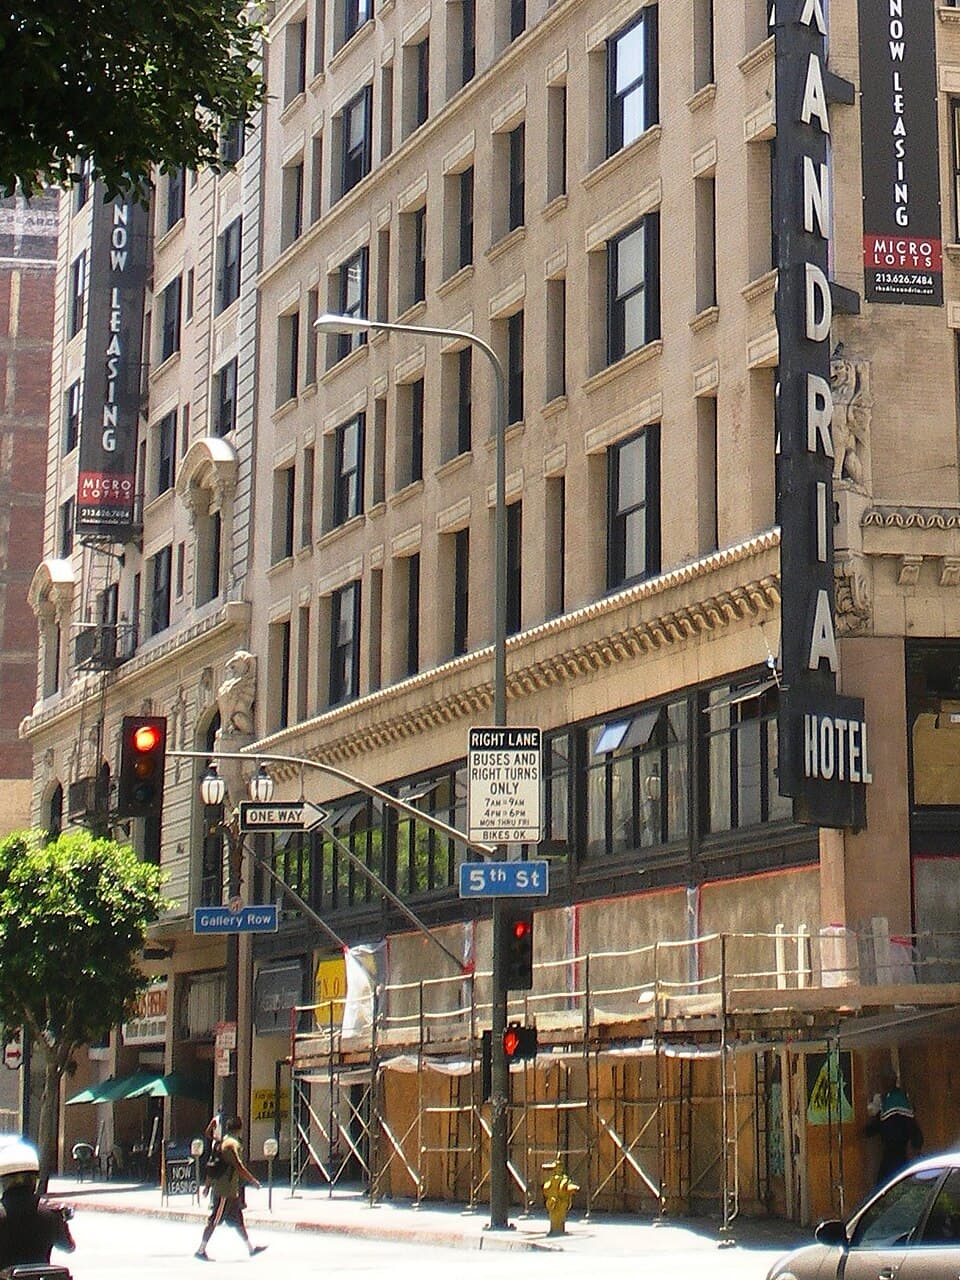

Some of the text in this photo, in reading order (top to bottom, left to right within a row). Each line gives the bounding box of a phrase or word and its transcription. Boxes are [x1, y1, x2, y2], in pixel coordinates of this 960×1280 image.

[893, 72, 909, 227] LEASING
[874, 239, 932, 256] MICRO
[874, 253, 932, 267] LOFTS
[875, 273, 933, 285] 213.626.7484
[102, 204, 128, 453] NOW LEASING
[83, 478, 131, 490] MICRO
[472, 733, 538, 746] RIGHT LANE
[804, 714, 873, 784] HOTEL
[473, 753, 536, 766] BUSES AND
[472, 768, 537, 780] RIGHT TURNS
[490, 783, 519, 795] ONLY
[249, 810, 302, 821] ONE WAY
[483, 831, 526, 839] BIKES OK
[469, 869, 540, 891] 5th St
[200, 914, 271, 927] Gallery Row
[172, 1166, 192, 1180] NOW
[168, 1181, 197, 1194] LEASING
